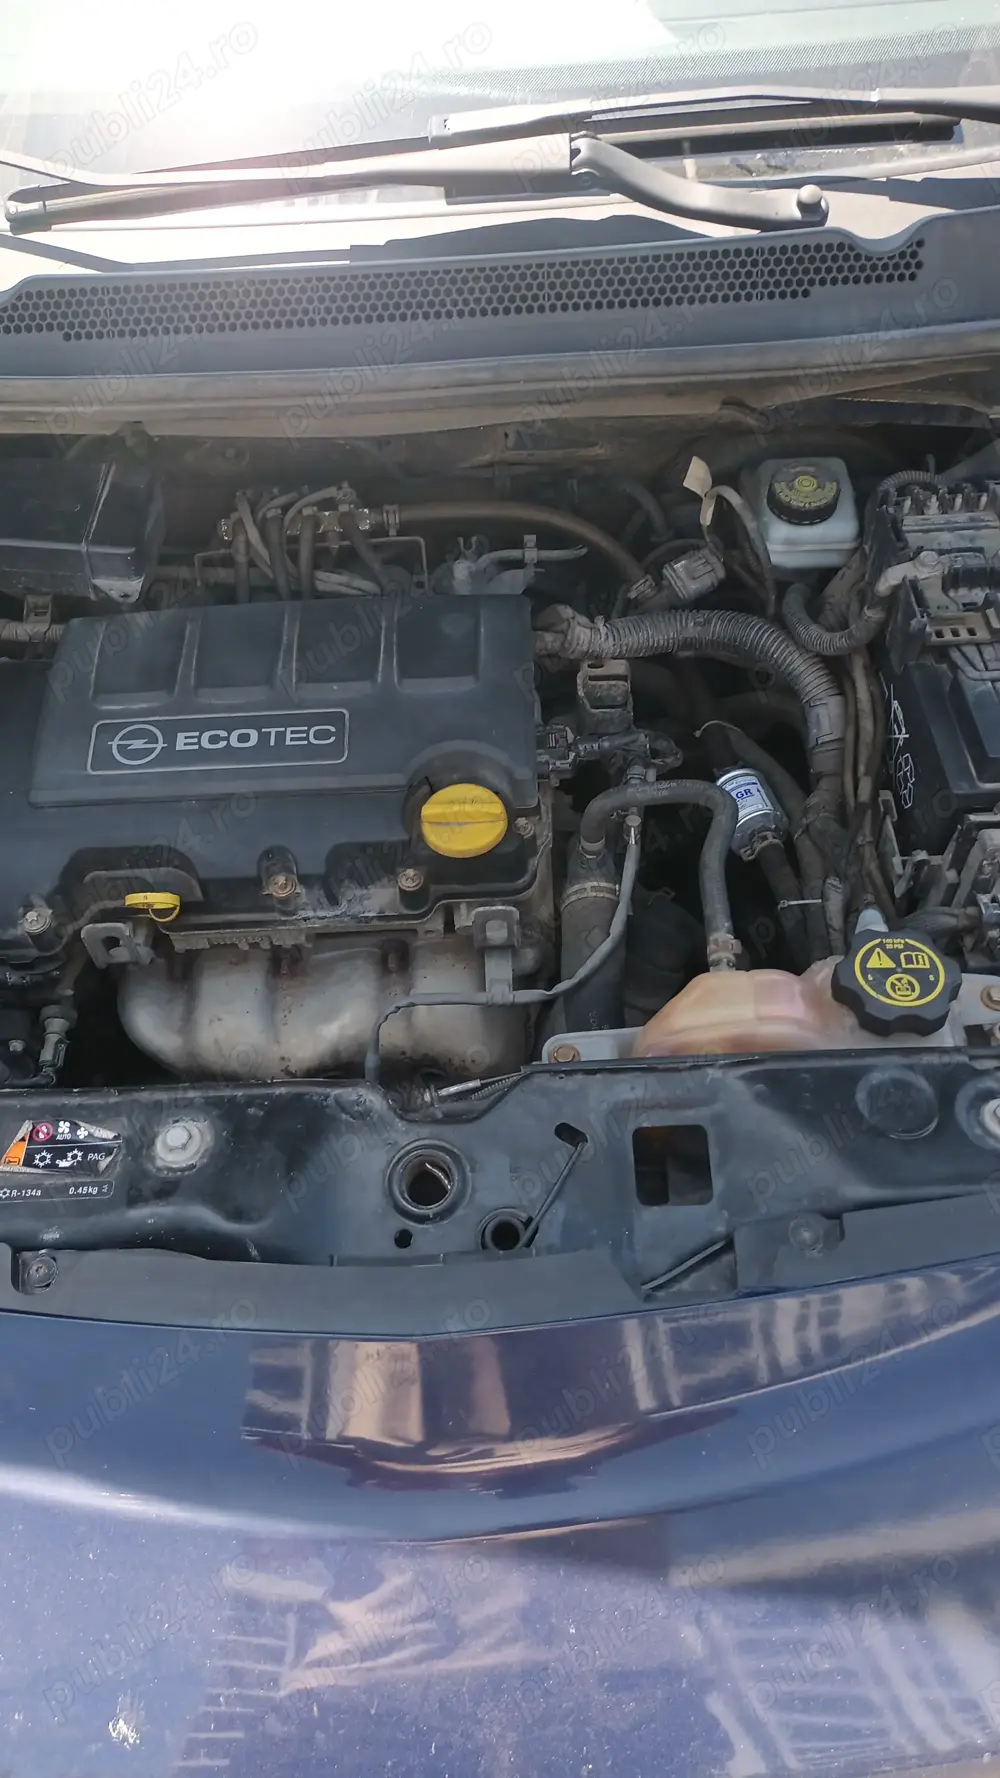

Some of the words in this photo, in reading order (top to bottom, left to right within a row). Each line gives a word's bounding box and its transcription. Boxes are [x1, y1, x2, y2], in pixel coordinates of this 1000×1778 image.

[175, 725, 336, 751] ECOTEC
[56, 1132, 71, 1140] AUTO
[87, 1152, 105, 1161] PAG
[11, 1188, 41, 1197] R-134a
